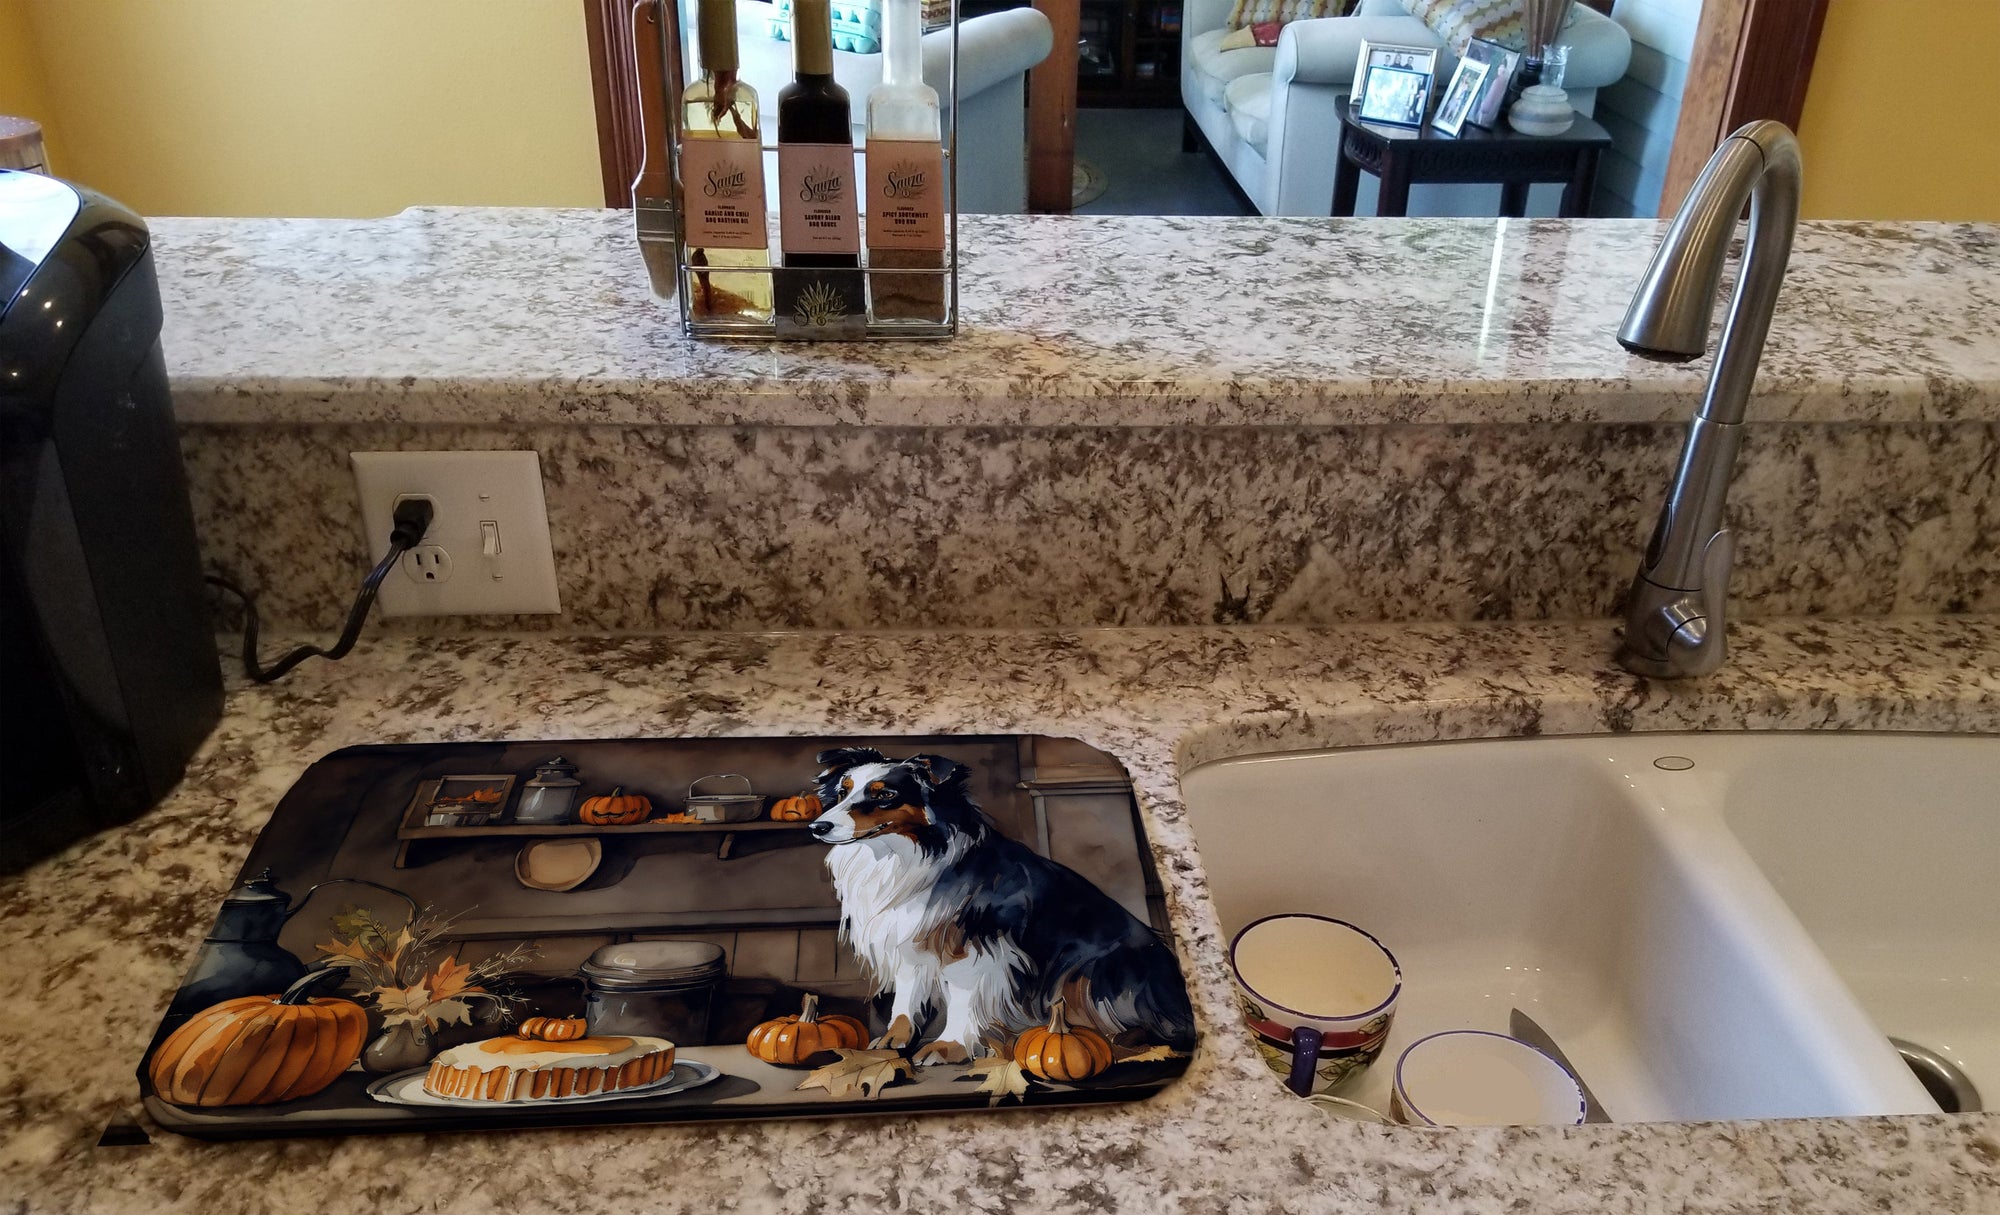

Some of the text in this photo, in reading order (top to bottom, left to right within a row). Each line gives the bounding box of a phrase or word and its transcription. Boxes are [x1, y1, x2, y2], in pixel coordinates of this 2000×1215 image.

[704, 170, 745, 197] Sauza
[800, 175, 842, 202] Sauza
[884, 171, 925, 198] Sauza
[793, 295, 843, 326] Sauza
